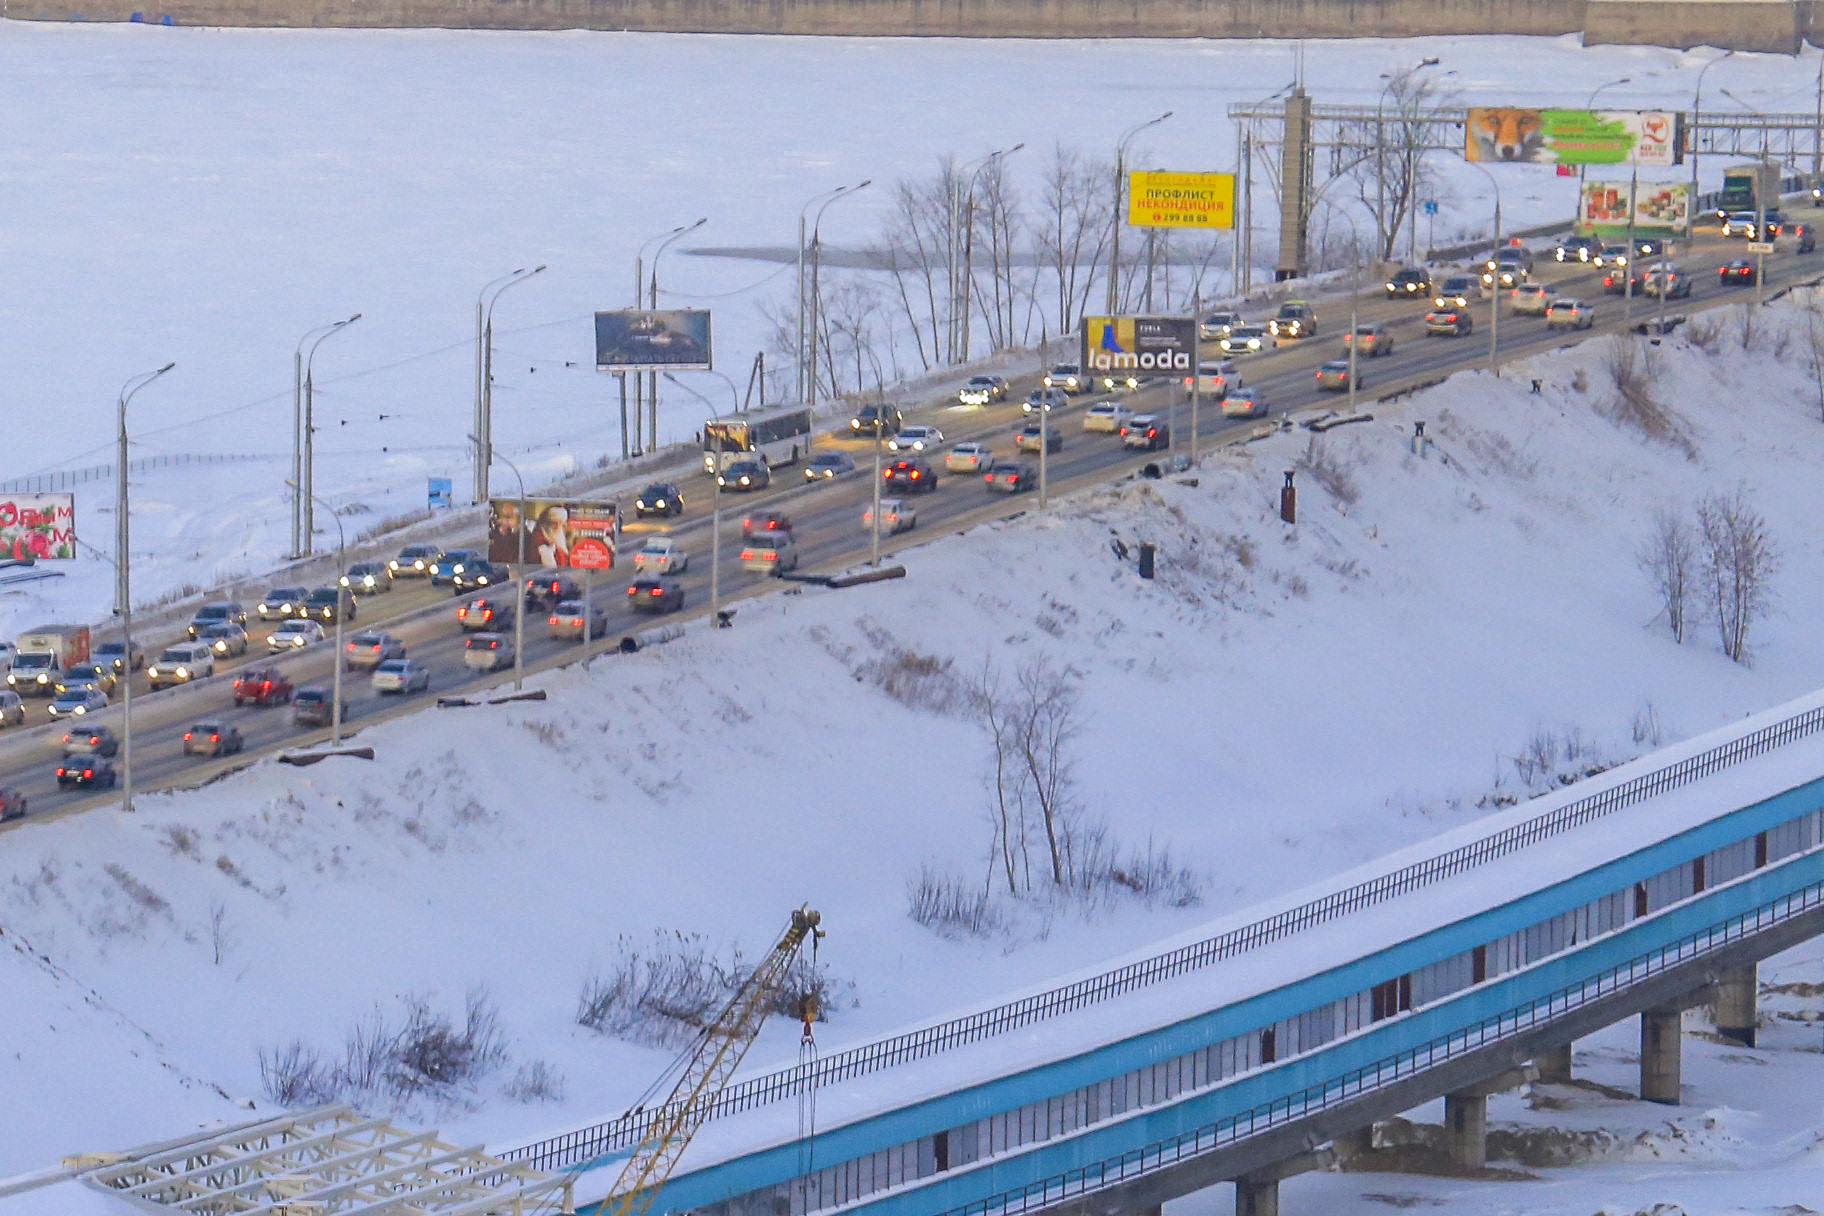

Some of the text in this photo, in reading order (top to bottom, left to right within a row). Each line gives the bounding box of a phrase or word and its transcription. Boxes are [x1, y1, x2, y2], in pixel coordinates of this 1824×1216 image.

[1146, 188, 1214, 200] ПРОФЛИСТ
[1137, 199, 1224, 212] НЕКОНДИЦИЯ
[1087, 348, 1190, 370] lamoda
